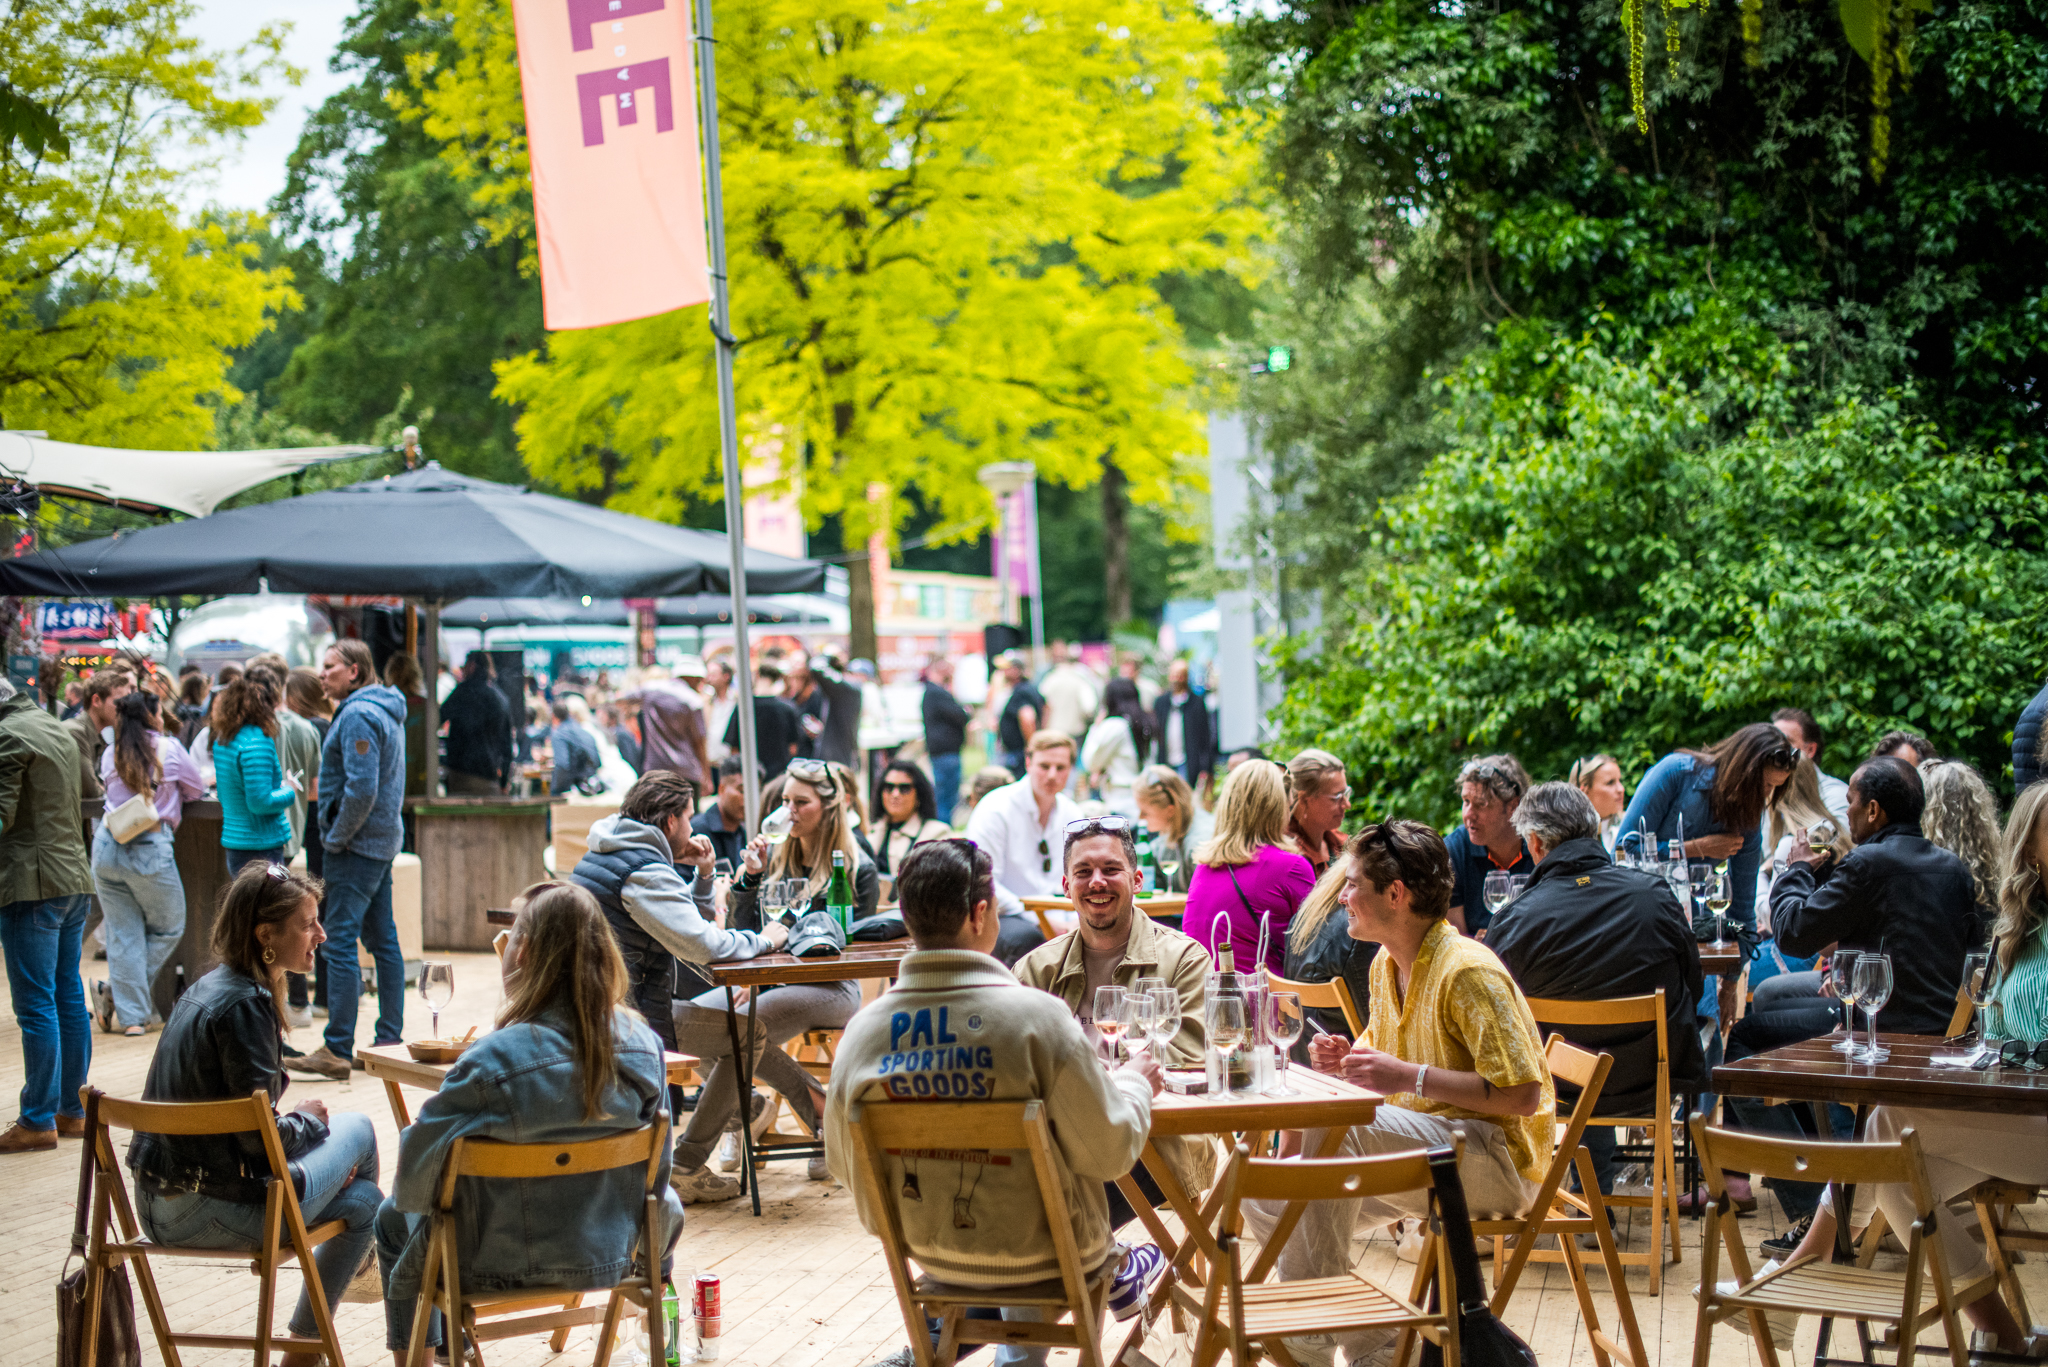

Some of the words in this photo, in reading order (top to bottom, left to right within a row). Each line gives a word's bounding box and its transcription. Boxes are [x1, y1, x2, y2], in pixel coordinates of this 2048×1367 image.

[890, 1006, 957, 1052] PAL
[878, 1046, 993, 1074] SPORTING
[889, 1073, 989, 1098] GOODS
